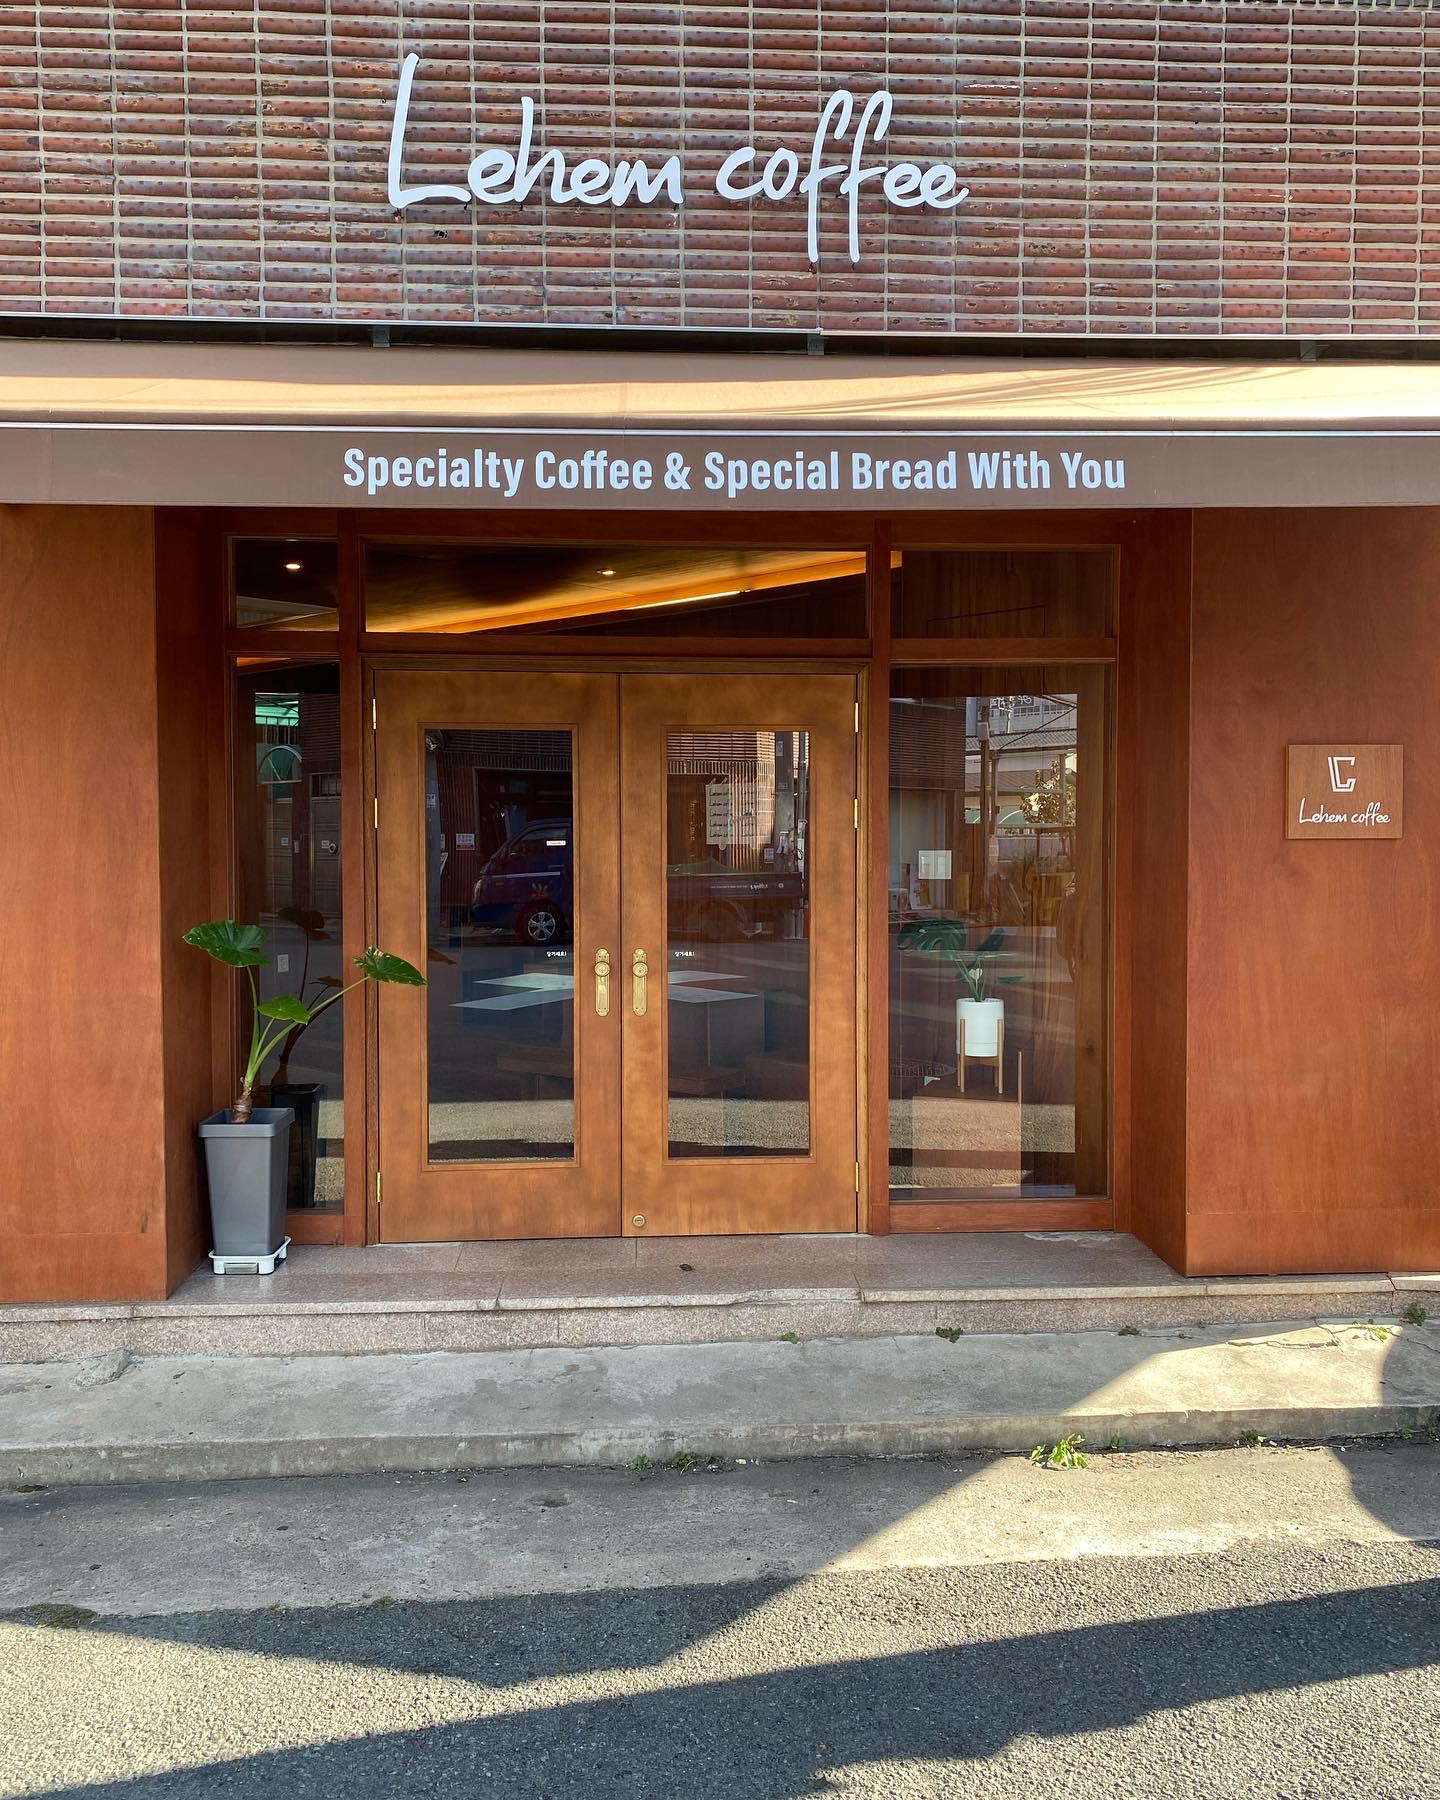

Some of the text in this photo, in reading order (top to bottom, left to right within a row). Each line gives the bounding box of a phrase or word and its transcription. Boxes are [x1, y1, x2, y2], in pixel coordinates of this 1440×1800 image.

[387, 52, 970, 264] Lehem coffee
[343, 447, 1126, 499] Specialty Coffee & Special Bread With You
[1299, 797, 1391, 827] Lehem coffee
